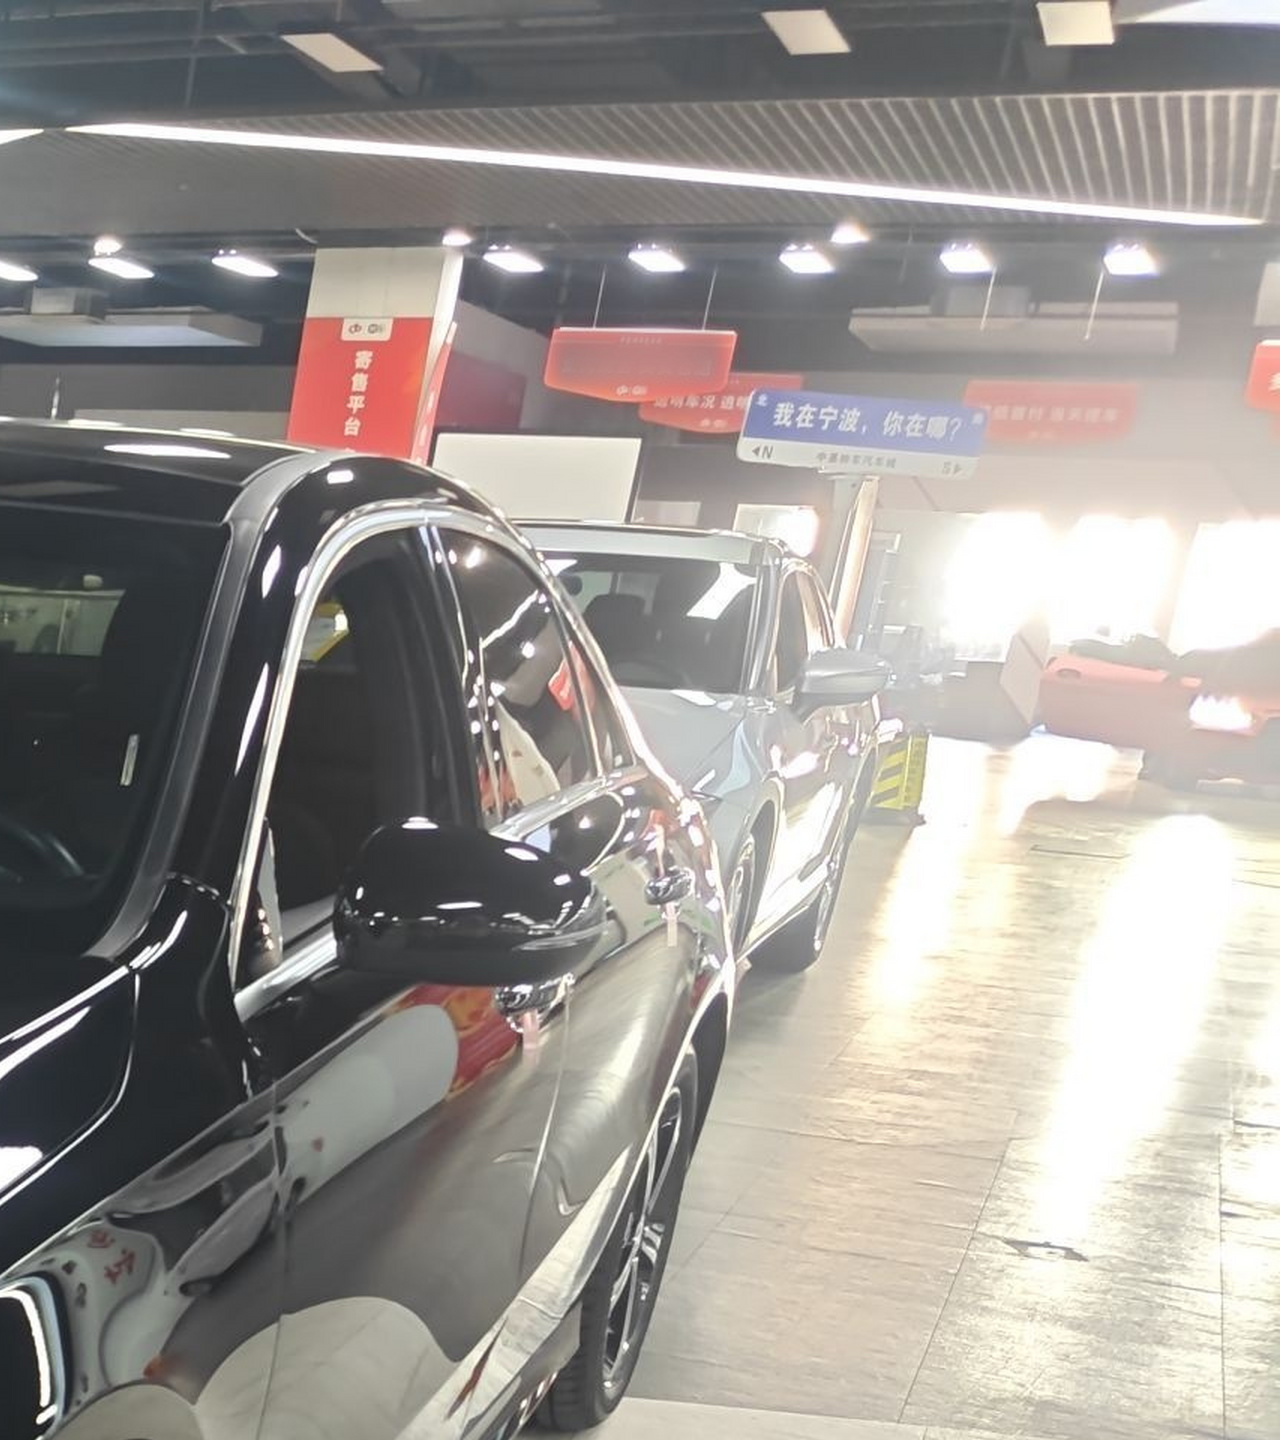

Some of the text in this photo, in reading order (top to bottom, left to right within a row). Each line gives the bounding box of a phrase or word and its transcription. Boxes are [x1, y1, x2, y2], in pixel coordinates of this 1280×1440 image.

[344, 350, 373, 436] 寄售平台
[761, 446, 774, 459] N
